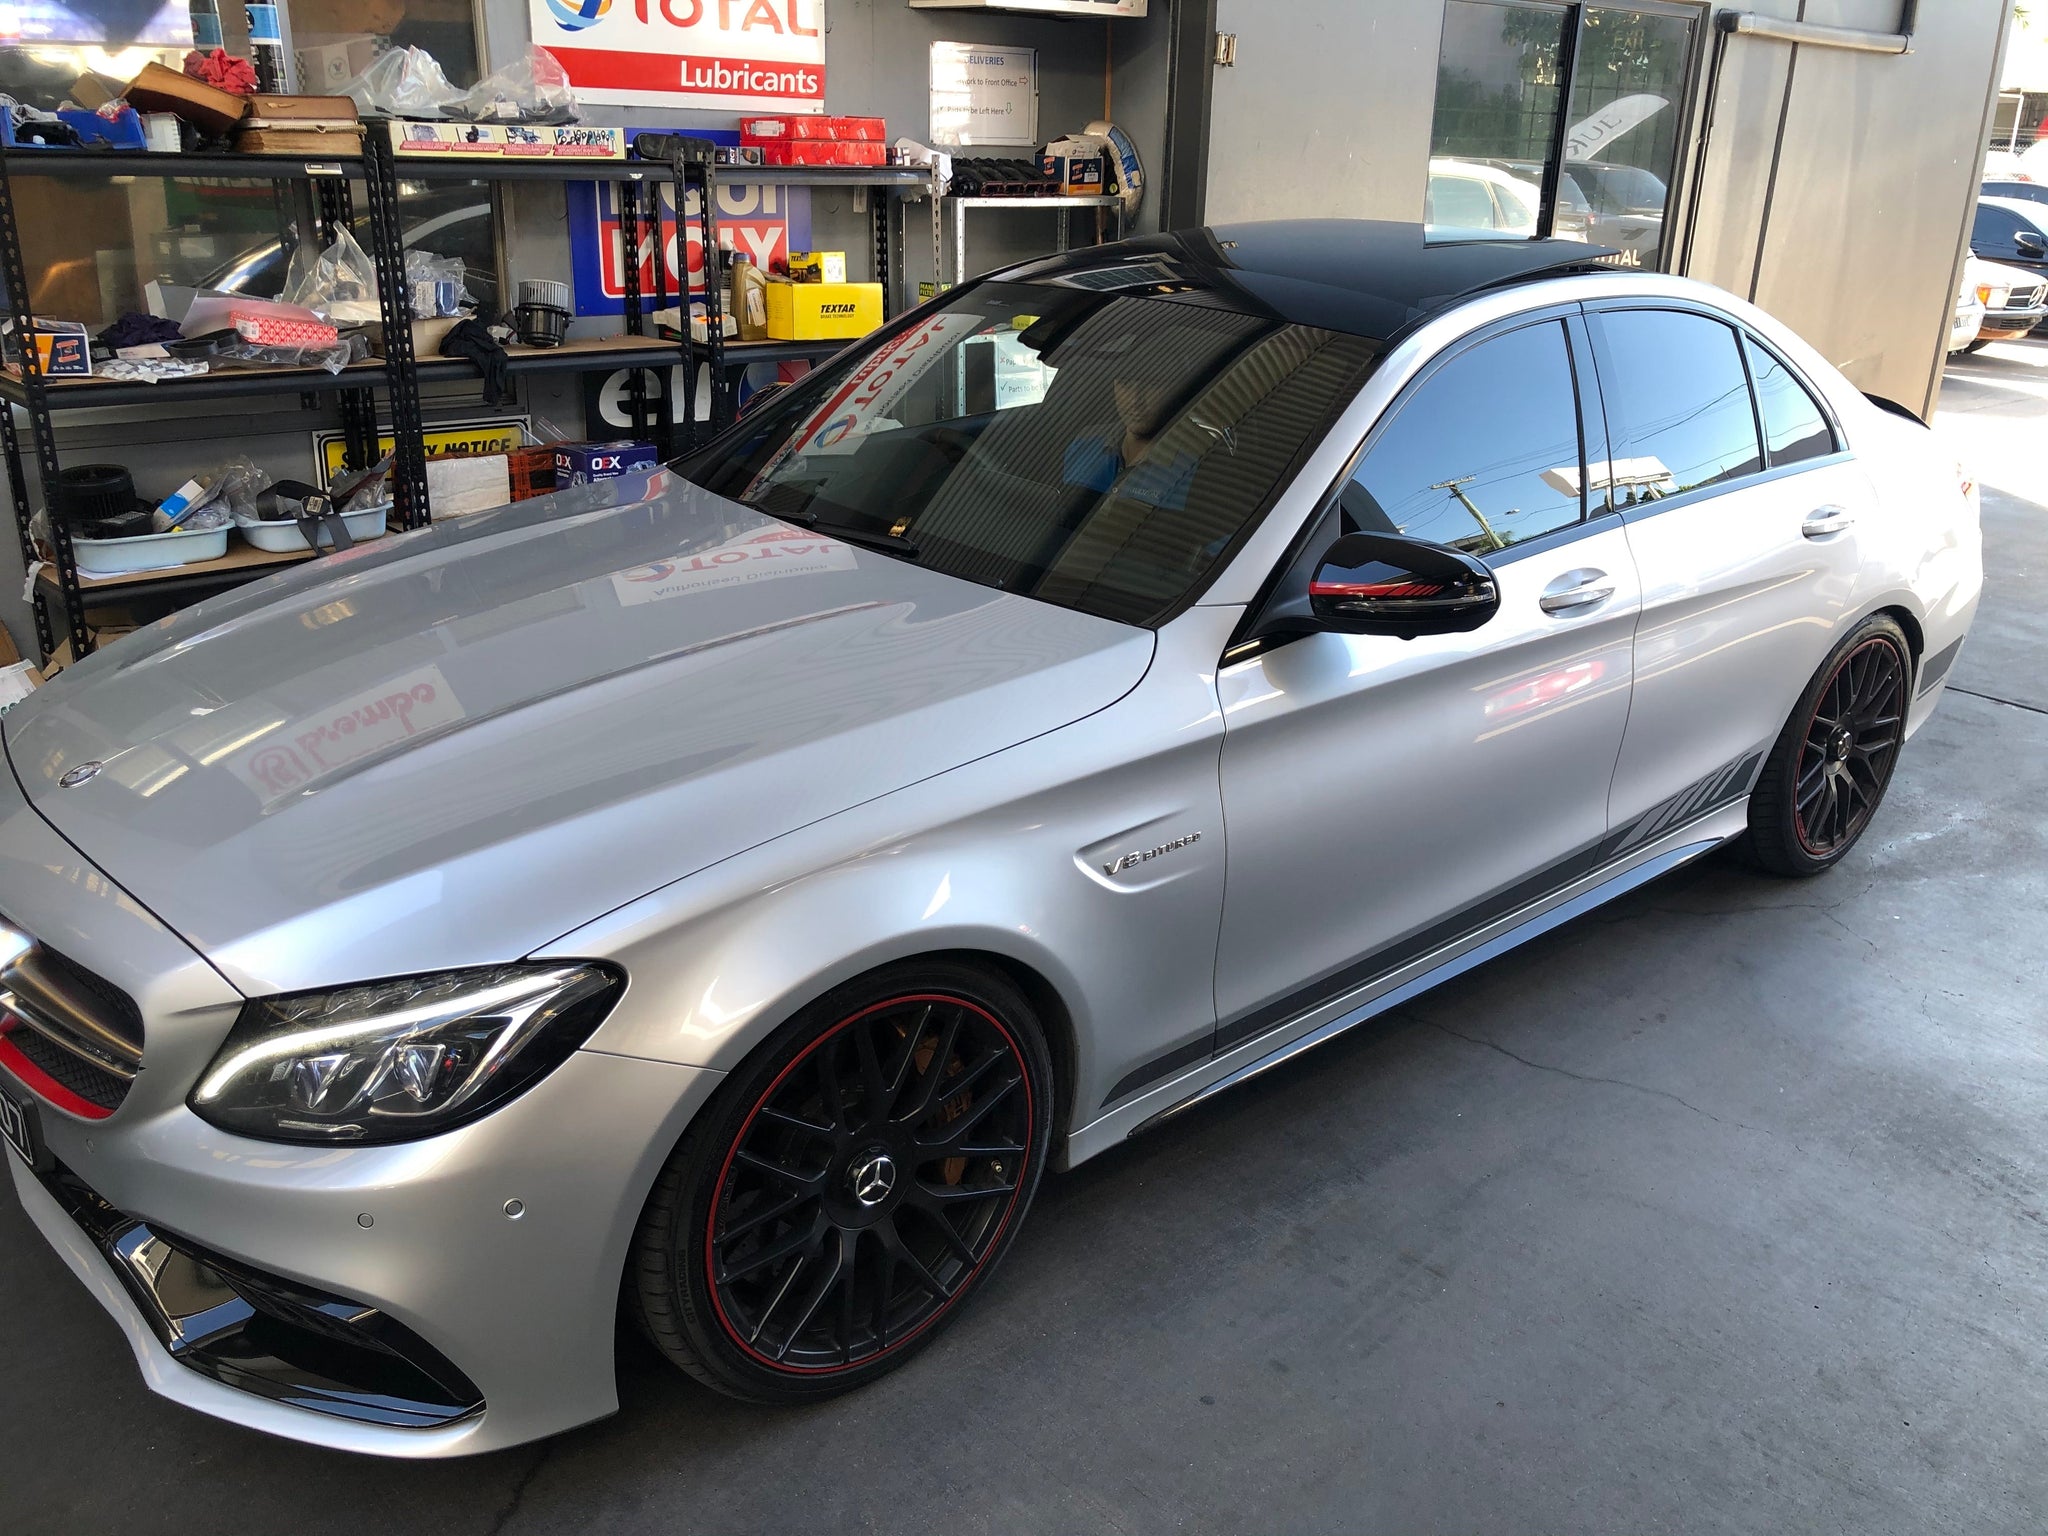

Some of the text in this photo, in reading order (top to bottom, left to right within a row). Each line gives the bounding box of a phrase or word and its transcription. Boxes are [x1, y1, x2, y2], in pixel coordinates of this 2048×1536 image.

[680, 60, 818, 94] Lubricants
[985, 78, 1000, 86] Front
[1001, 79, 1018, 87] Office
[979, 107, 990, 115] Left
[820, 304, 855, 313] TEXTAR
[592, 455, 622, 470] OEX
[1102, 831, 1202, 876] V8 BITURBO
